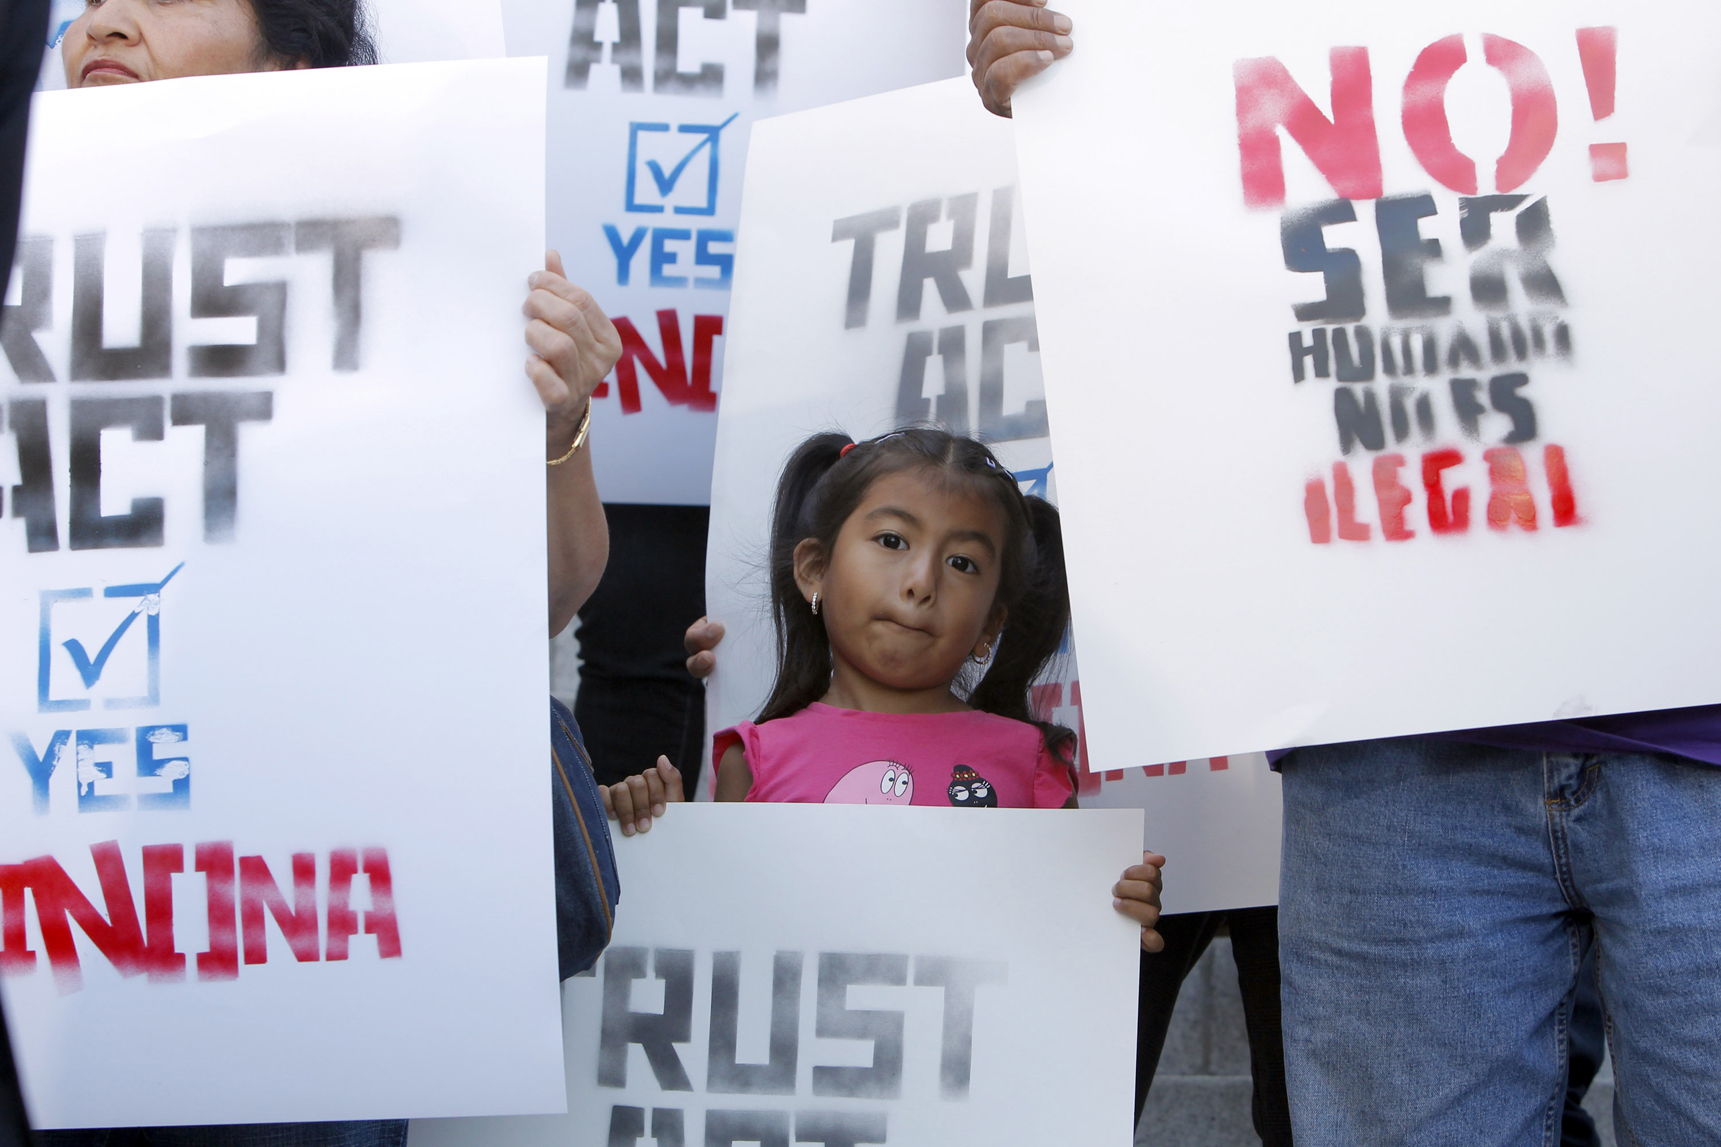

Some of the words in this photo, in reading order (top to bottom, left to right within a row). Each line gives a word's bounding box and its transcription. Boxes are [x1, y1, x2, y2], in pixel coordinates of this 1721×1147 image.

[563, 0, 808, 101] ACT
[1233, 25, 1631, 211] NO!
[602, 224, 734, 290] YES
[1280, 191, 1569, 324] SER
[8, 723, 192, 817] YES
[570, 945, 1006, 1101] RUST
